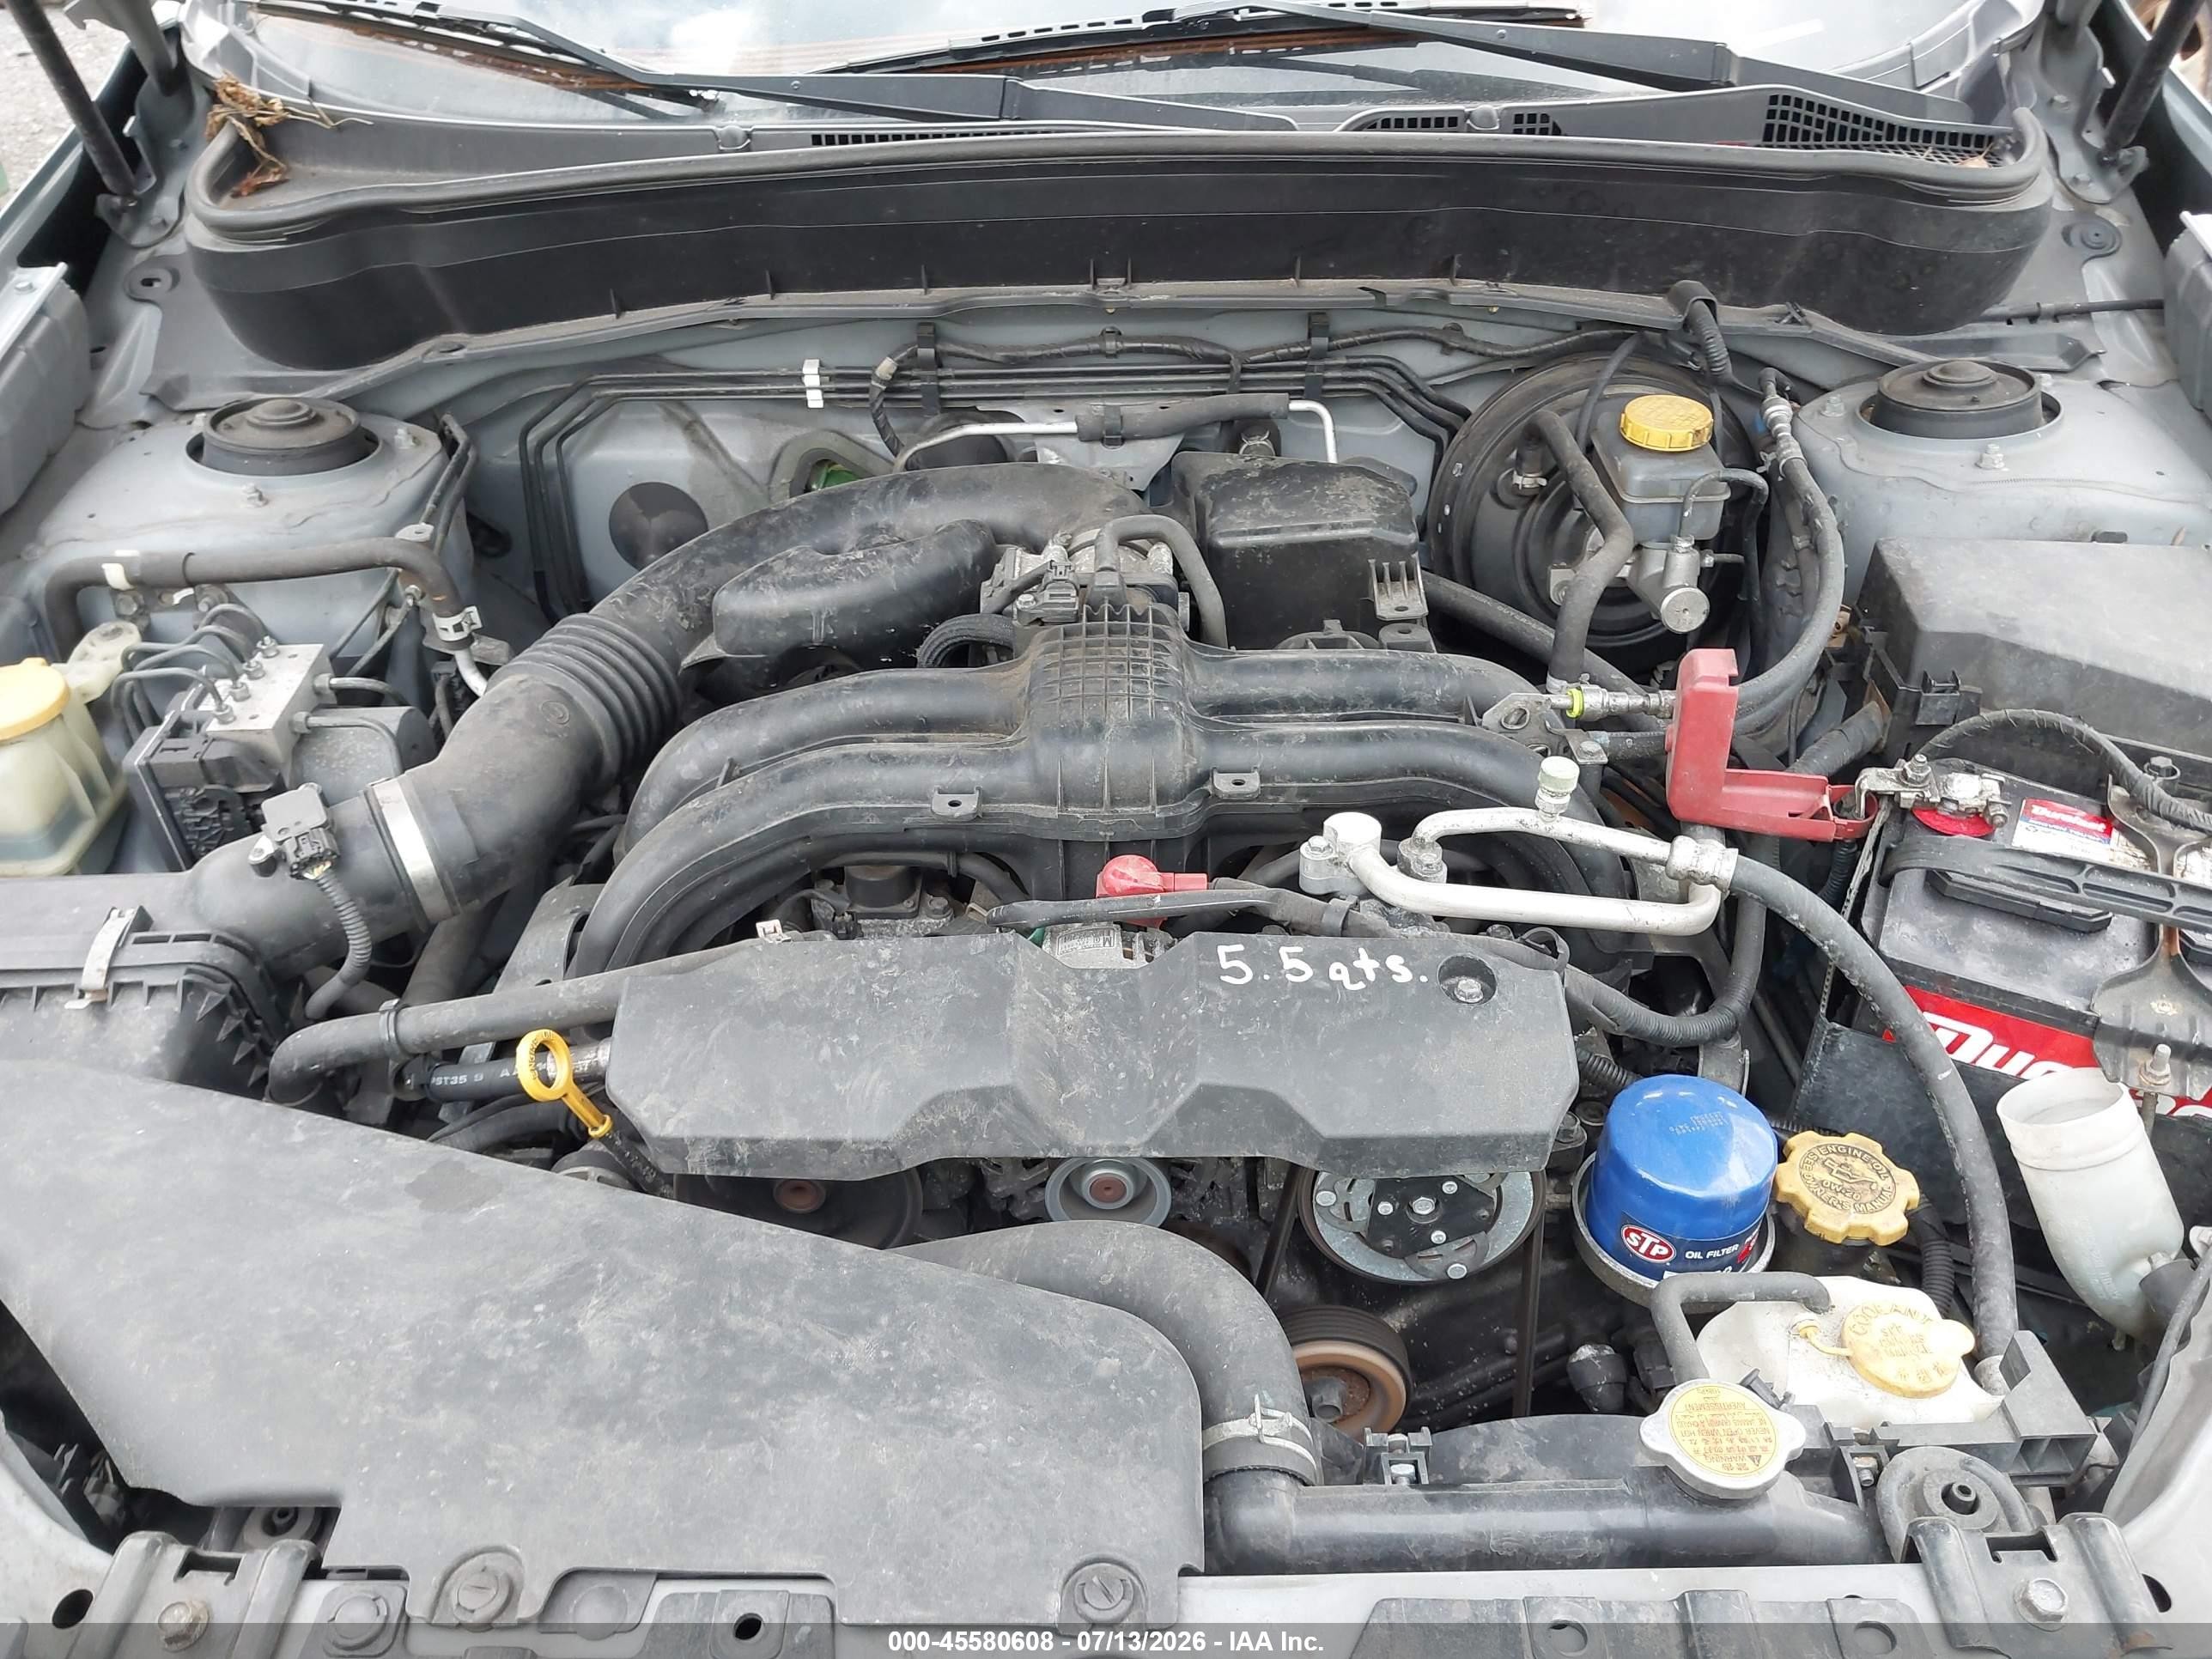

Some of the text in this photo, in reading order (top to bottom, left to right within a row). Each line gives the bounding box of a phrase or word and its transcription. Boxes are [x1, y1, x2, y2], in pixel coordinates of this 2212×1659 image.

[1216, 943, 1429, 991] 5.5 qts.
[1819, 1144, 1890, 1181] ENGINE OIL
[1802, 1152, 1893, 1214] SEE OWNER'S MANUAL
[1626, 1230, 1671, 1258] STP
[1685, 1243, 1740, 1260] OIL FILTER
[1745, 1426, 1771, 1436] NEVER
[1704, 1455, 1747, 1464] WARNING
